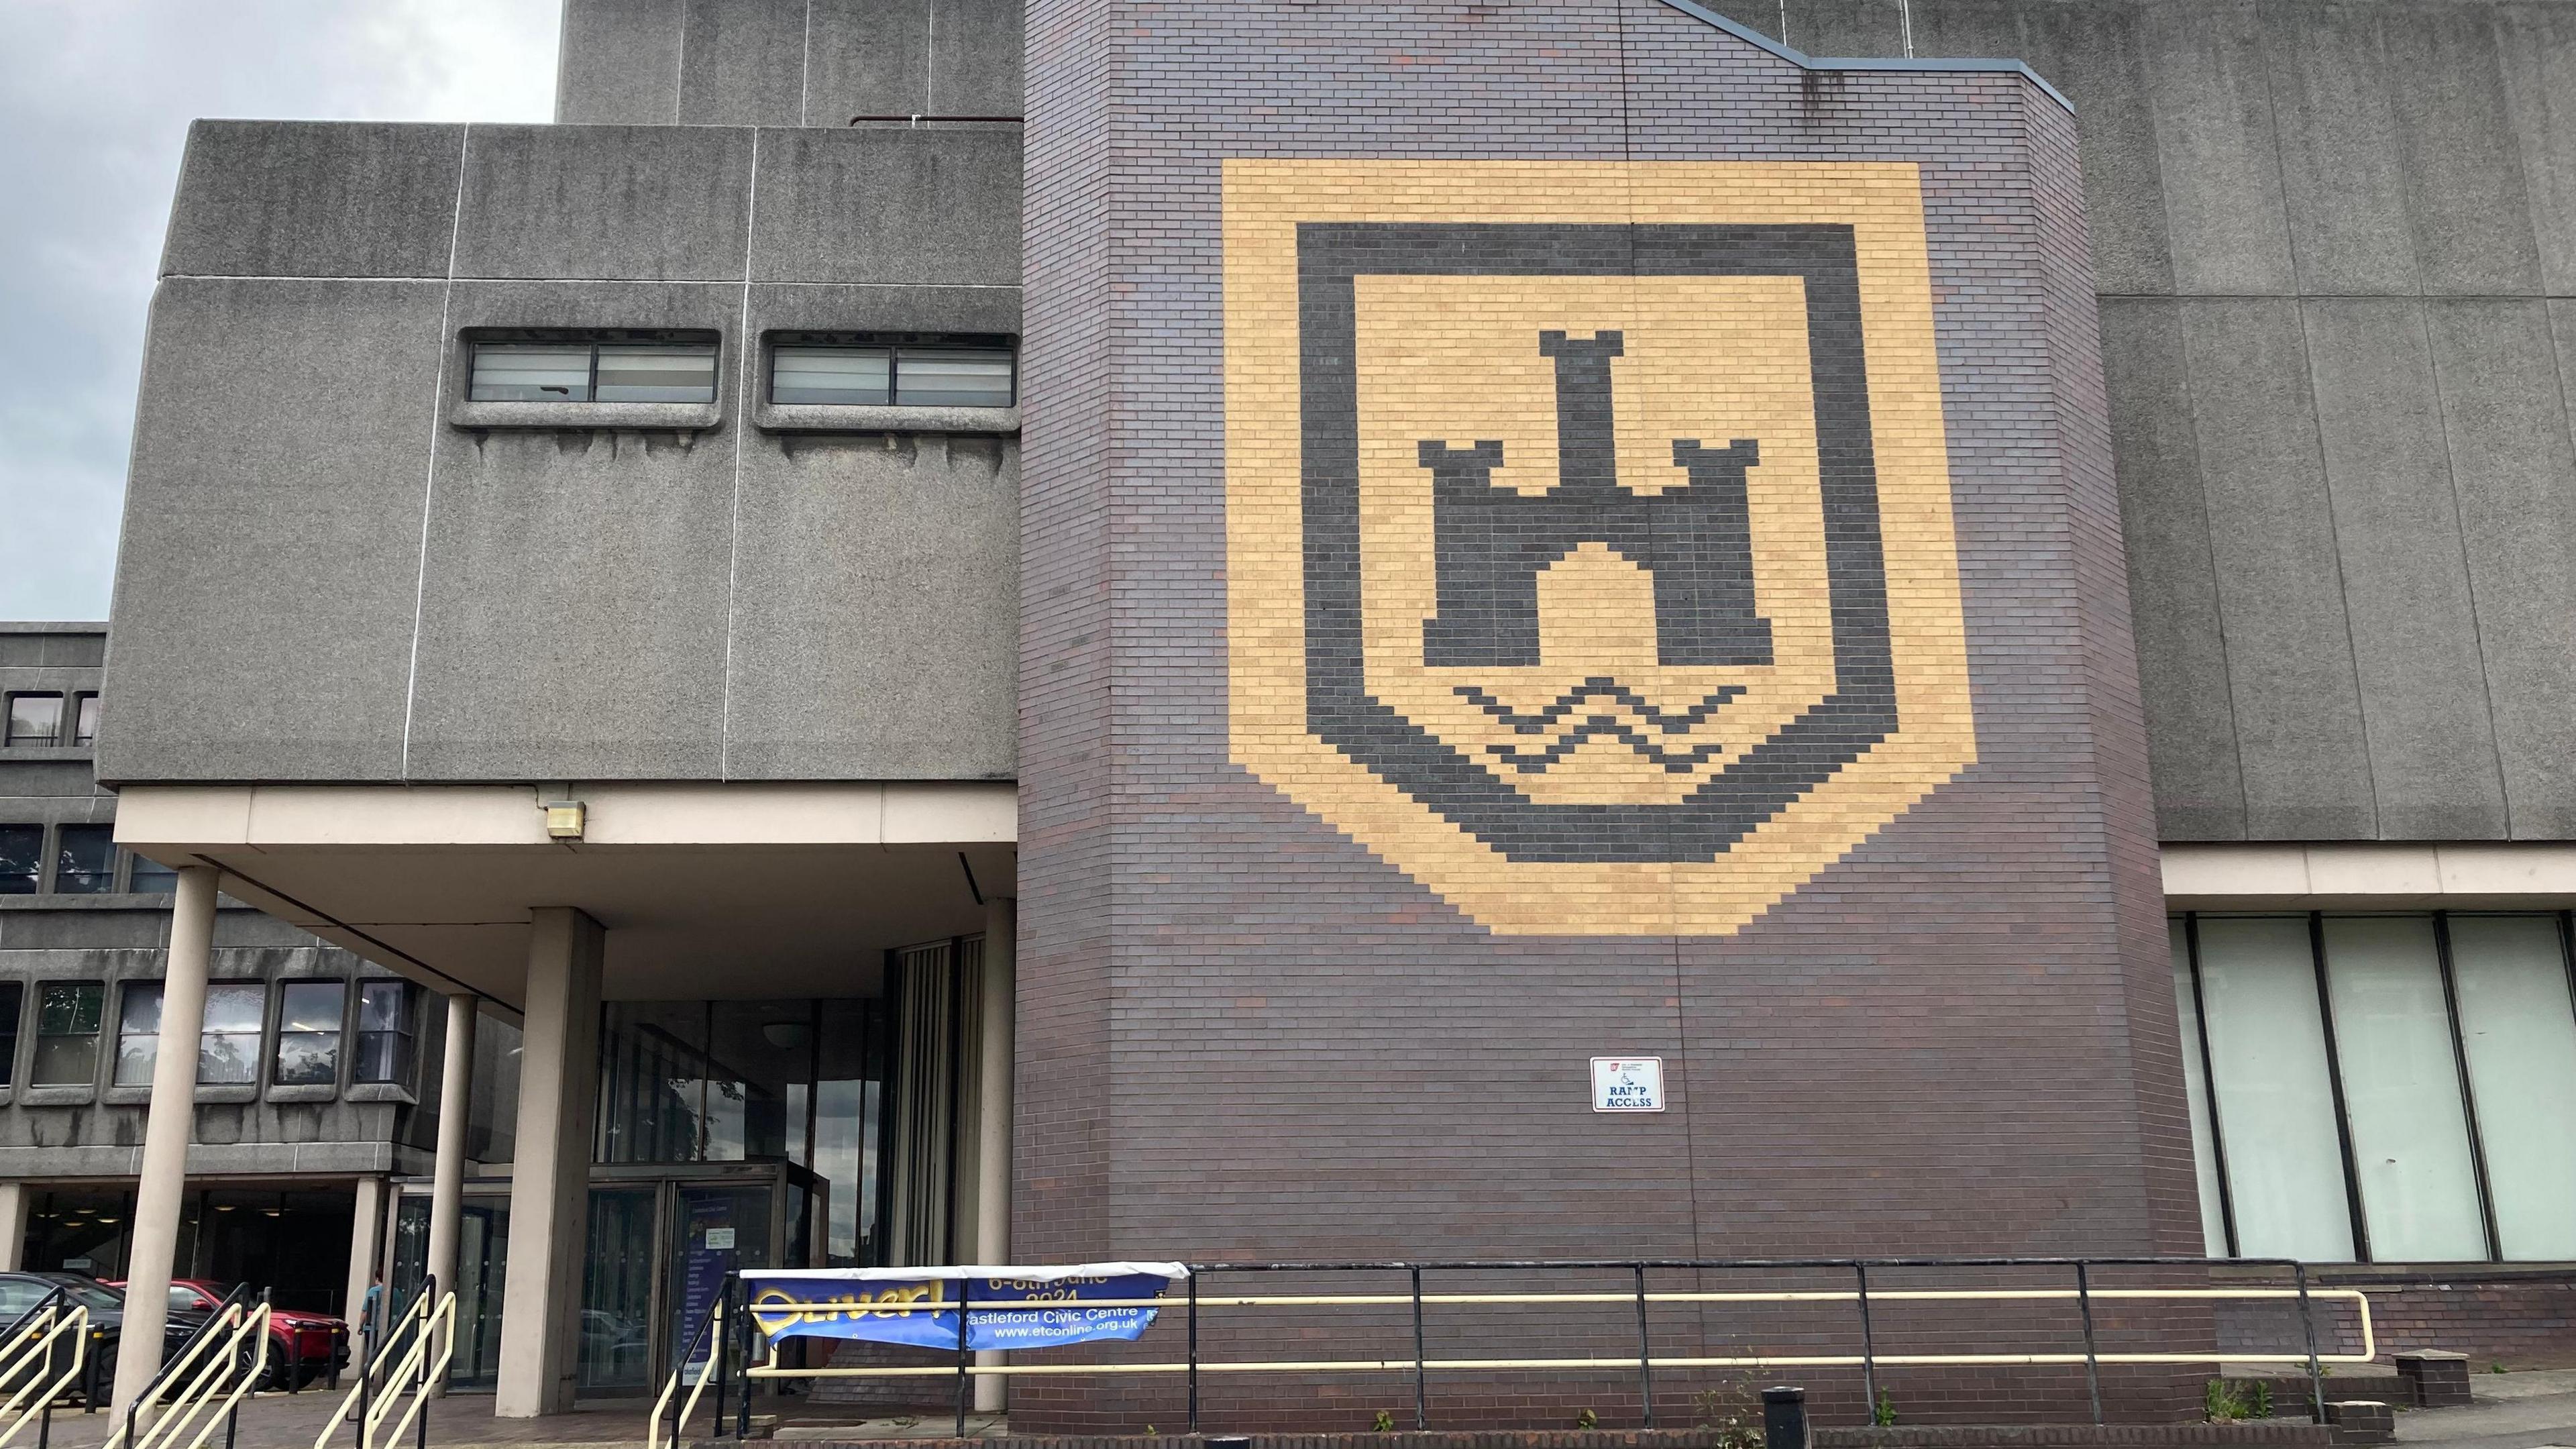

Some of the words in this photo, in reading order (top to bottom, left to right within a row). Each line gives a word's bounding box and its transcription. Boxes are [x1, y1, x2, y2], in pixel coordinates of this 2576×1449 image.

[1607, 1098, 1652, 1107] ACCESS
[967, 1311, 1038, 1326] astleford
[1043, 1309, 1081, 1324] Civic
[1085, 1307, 1138, 1321] Centre
[994, 1318, 1138, 1338] www.etconline.org.uk
